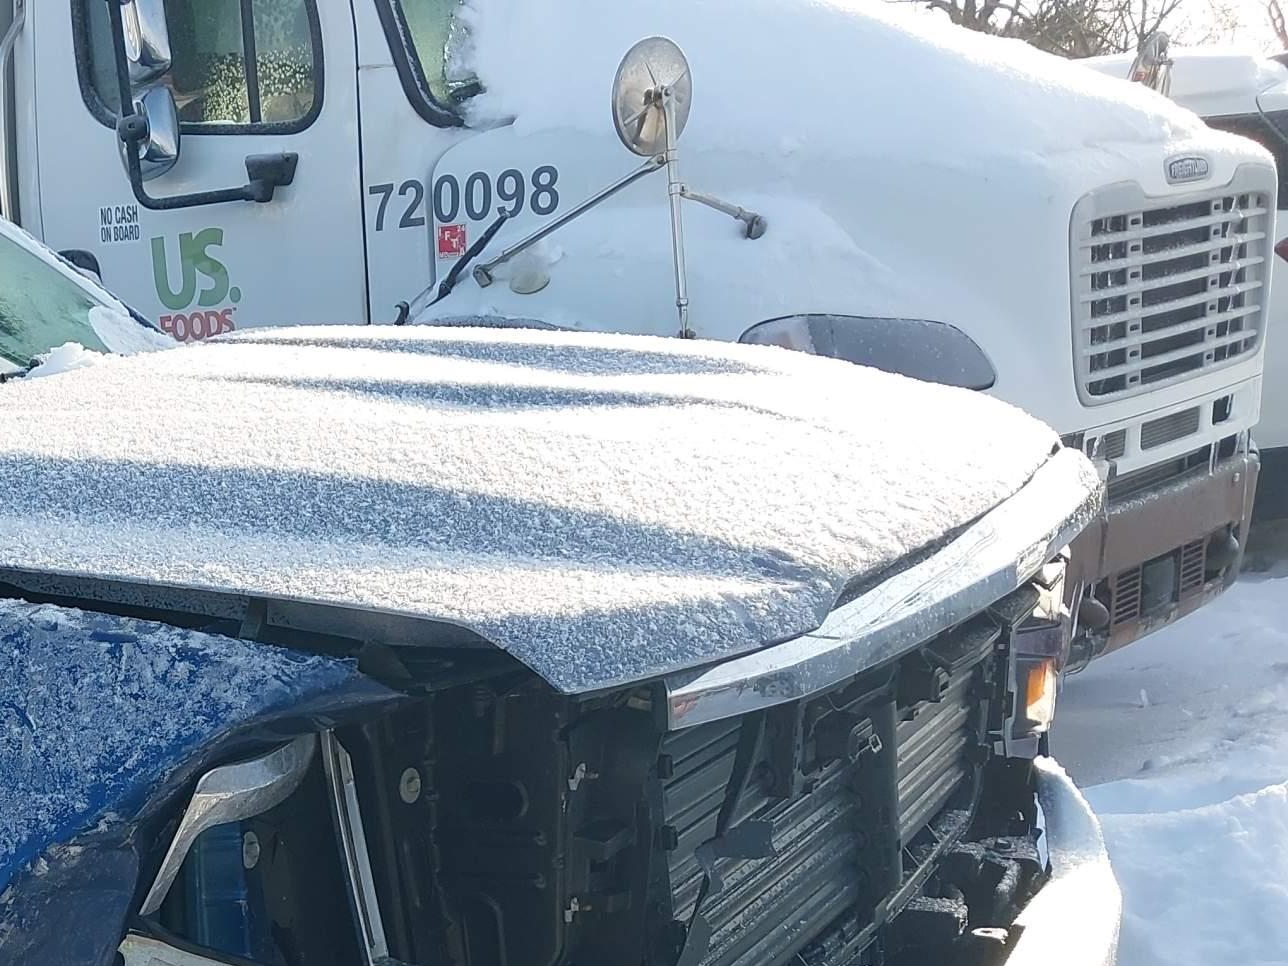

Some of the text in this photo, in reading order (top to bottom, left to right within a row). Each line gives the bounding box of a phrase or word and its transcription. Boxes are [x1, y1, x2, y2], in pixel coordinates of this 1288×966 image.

[100, 204, 139, 225] NO CASH
[368, 165, 559, 232] 720098
[100, 224, 140, 243] ON BOARD
[151, 227, 242, 311] US.
[159, 308, 235, 342] FOODS
